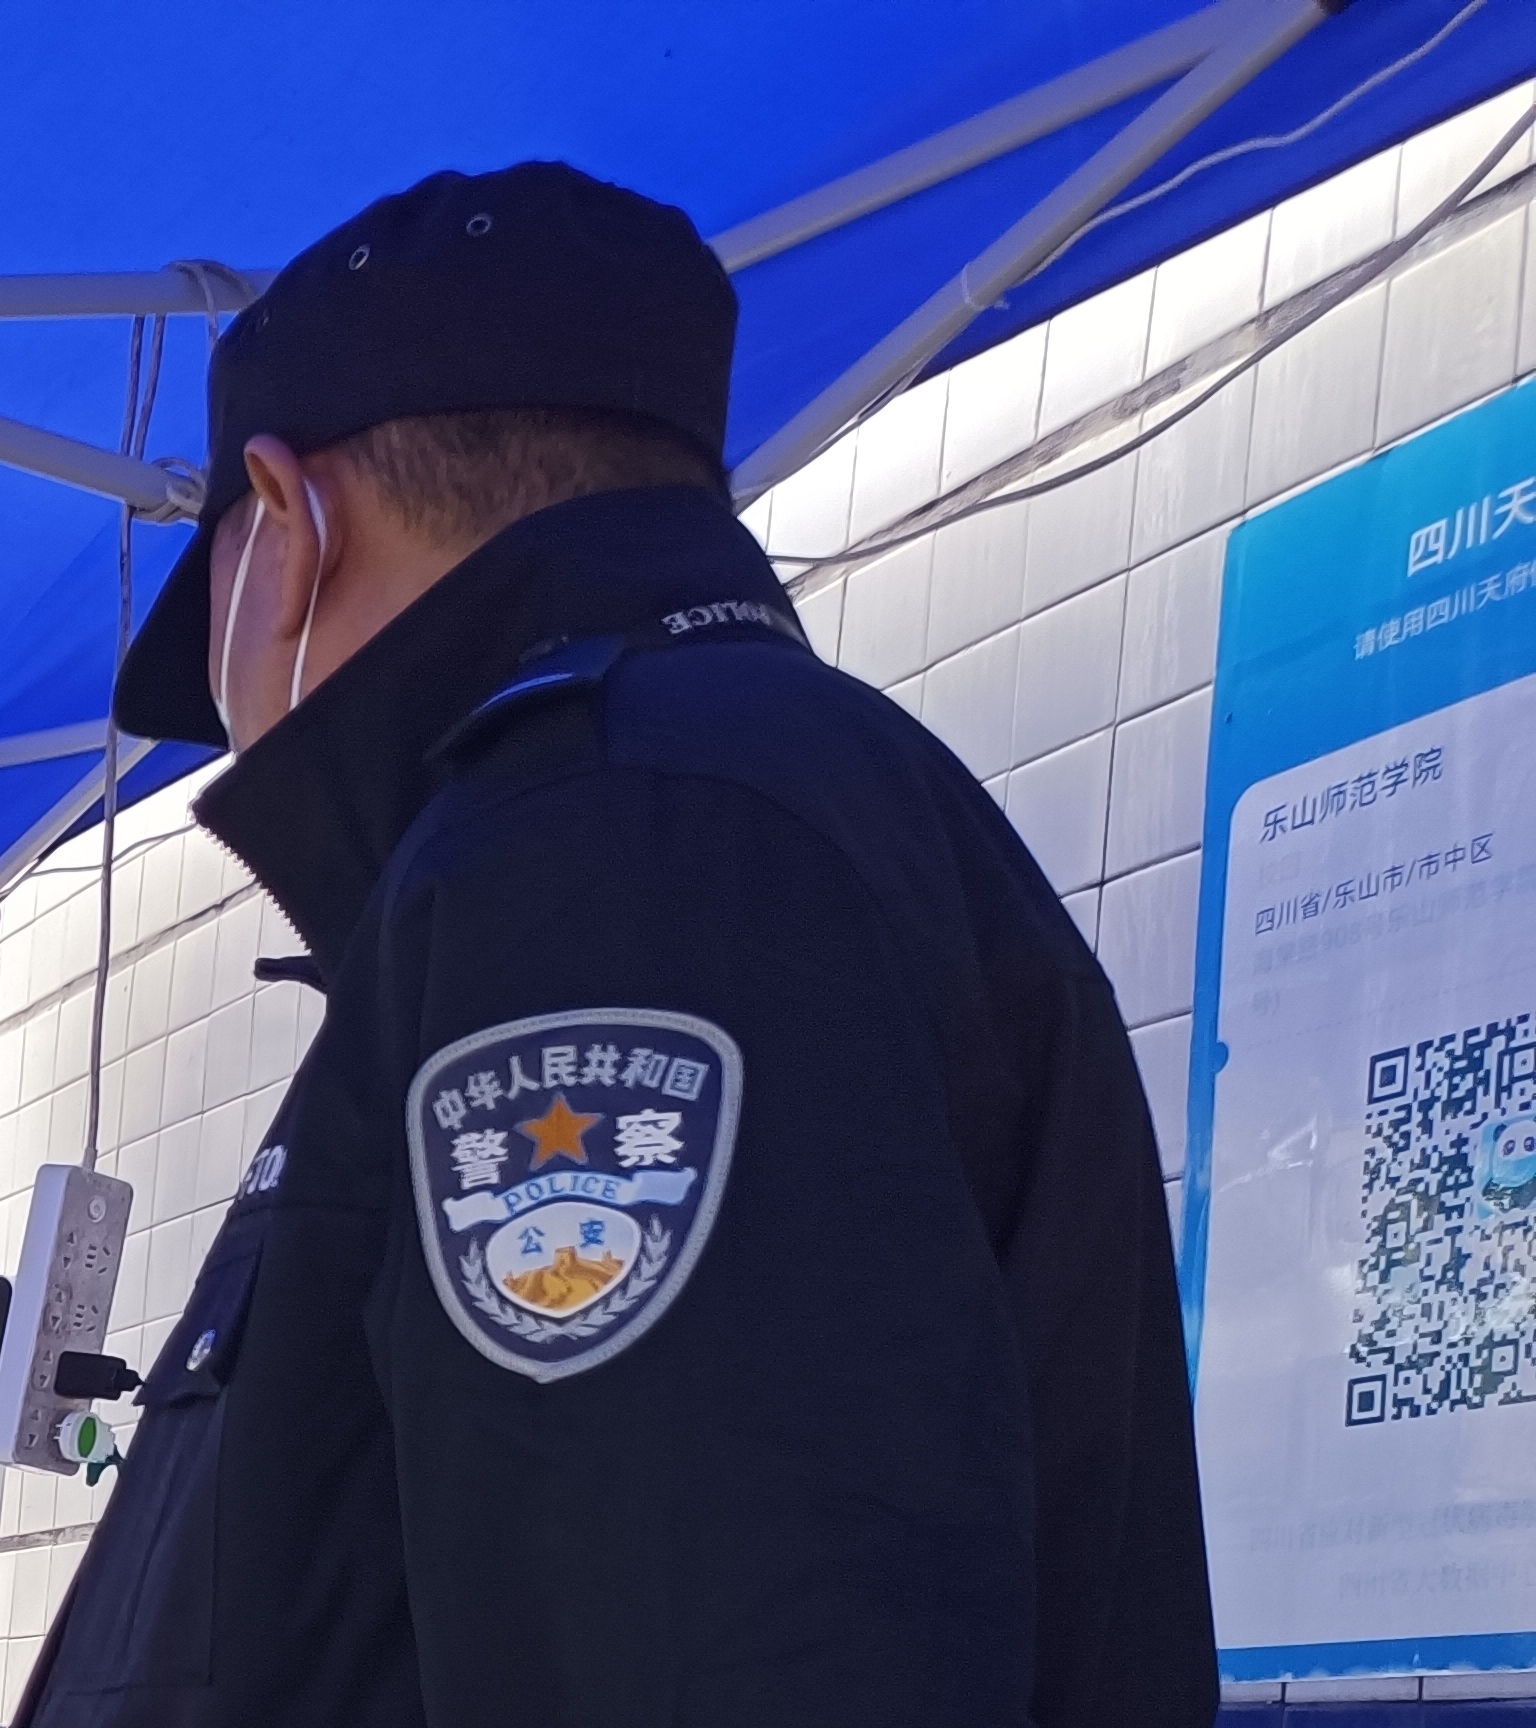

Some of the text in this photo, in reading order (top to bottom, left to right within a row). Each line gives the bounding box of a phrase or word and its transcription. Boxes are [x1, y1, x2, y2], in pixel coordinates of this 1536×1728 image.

[1259, 746, 1444, 844] 乐山师范学院
[1255, 833, 1494, 935] 四川省/乐山市/市中区
[432, 1044, 710, 1131] 中华人民共和国
[503, 1174, 622, 1217] POLICE
